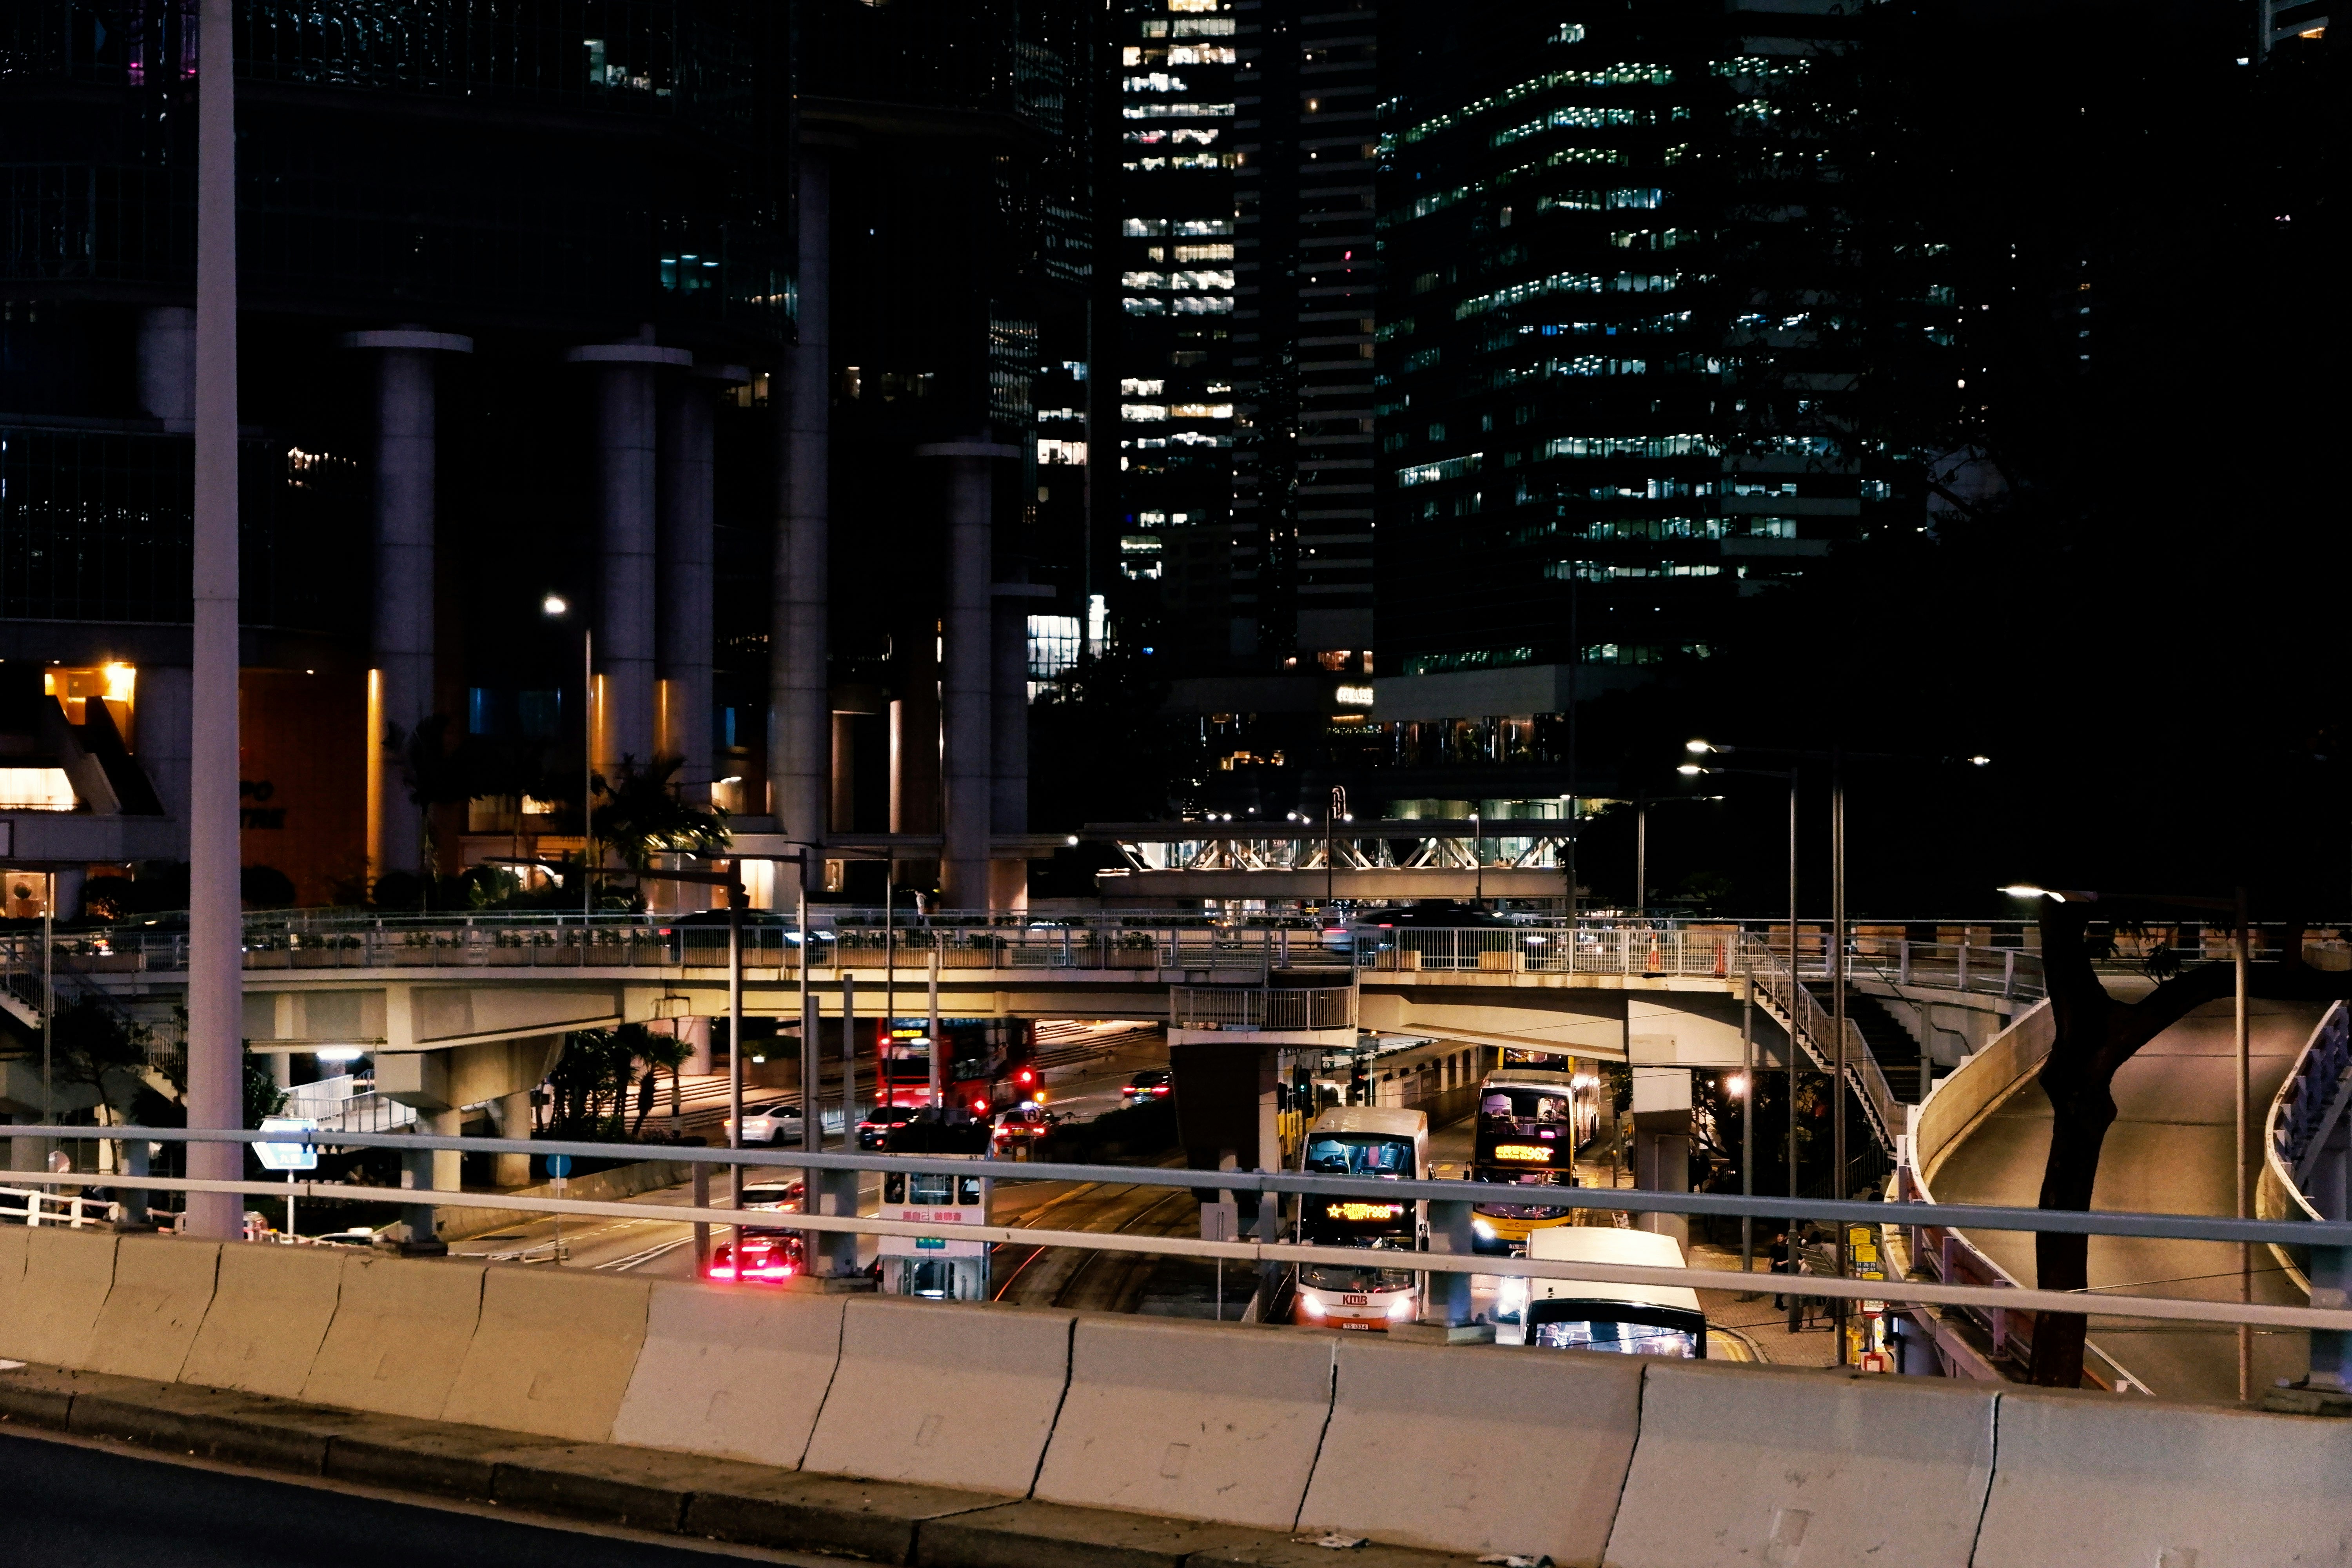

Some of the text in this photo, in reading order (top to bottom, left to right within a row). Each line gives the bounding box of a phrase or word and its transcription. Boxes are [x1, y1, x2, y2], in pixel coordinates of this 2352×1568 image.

[1527, 1147, 1550, 1160] 962
[1367, 1206, 1391, 1218] P968
[1343, 1295, 1368, 1305] KMB
